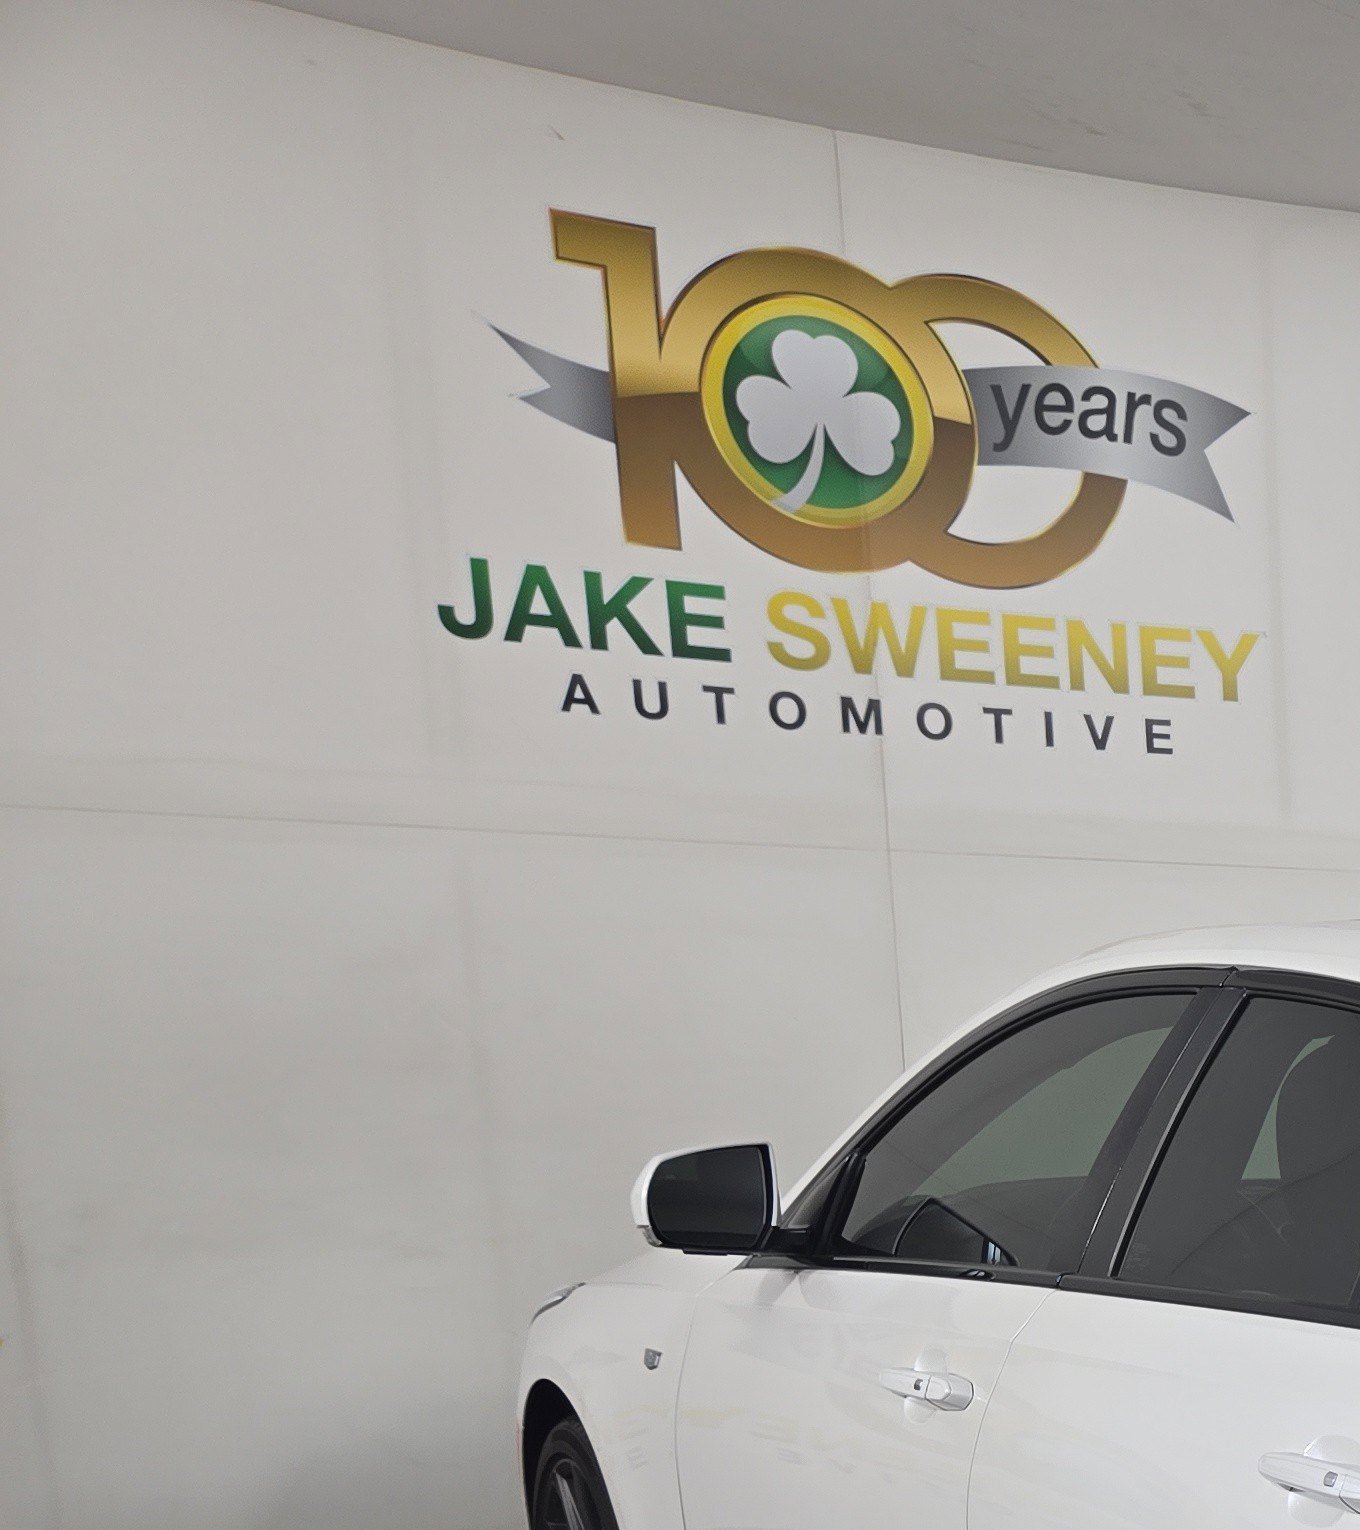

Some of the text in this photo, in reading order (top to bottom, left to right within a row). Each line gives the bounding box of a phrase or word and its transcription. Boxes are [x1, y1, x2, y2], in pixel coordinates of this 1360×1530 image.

[549, 207, 1128, 589] 100
[990, 380, 1189, 458] years
[437, 556, 1262, 703] JAKE SWEENEY
[561, 672, 1175, 755] AUTOMOTIVE
